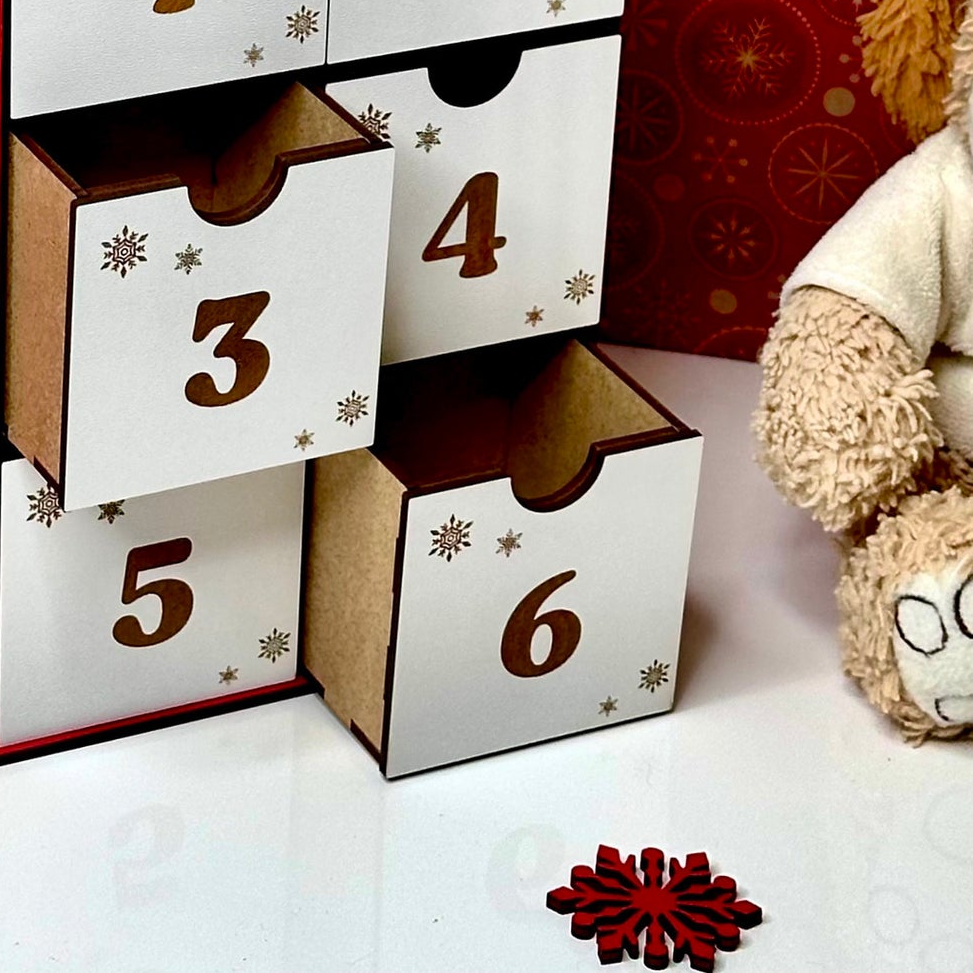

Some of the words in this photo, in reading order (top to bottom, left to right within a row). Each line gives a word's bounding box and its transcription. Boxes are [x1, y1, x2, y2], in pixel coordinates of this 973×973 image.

[422, 172, 506, 278] 4
[185, 291, 270, 407] 3
[113, 538, 193, 647] 5
[501, 570, 581, 678] 6
